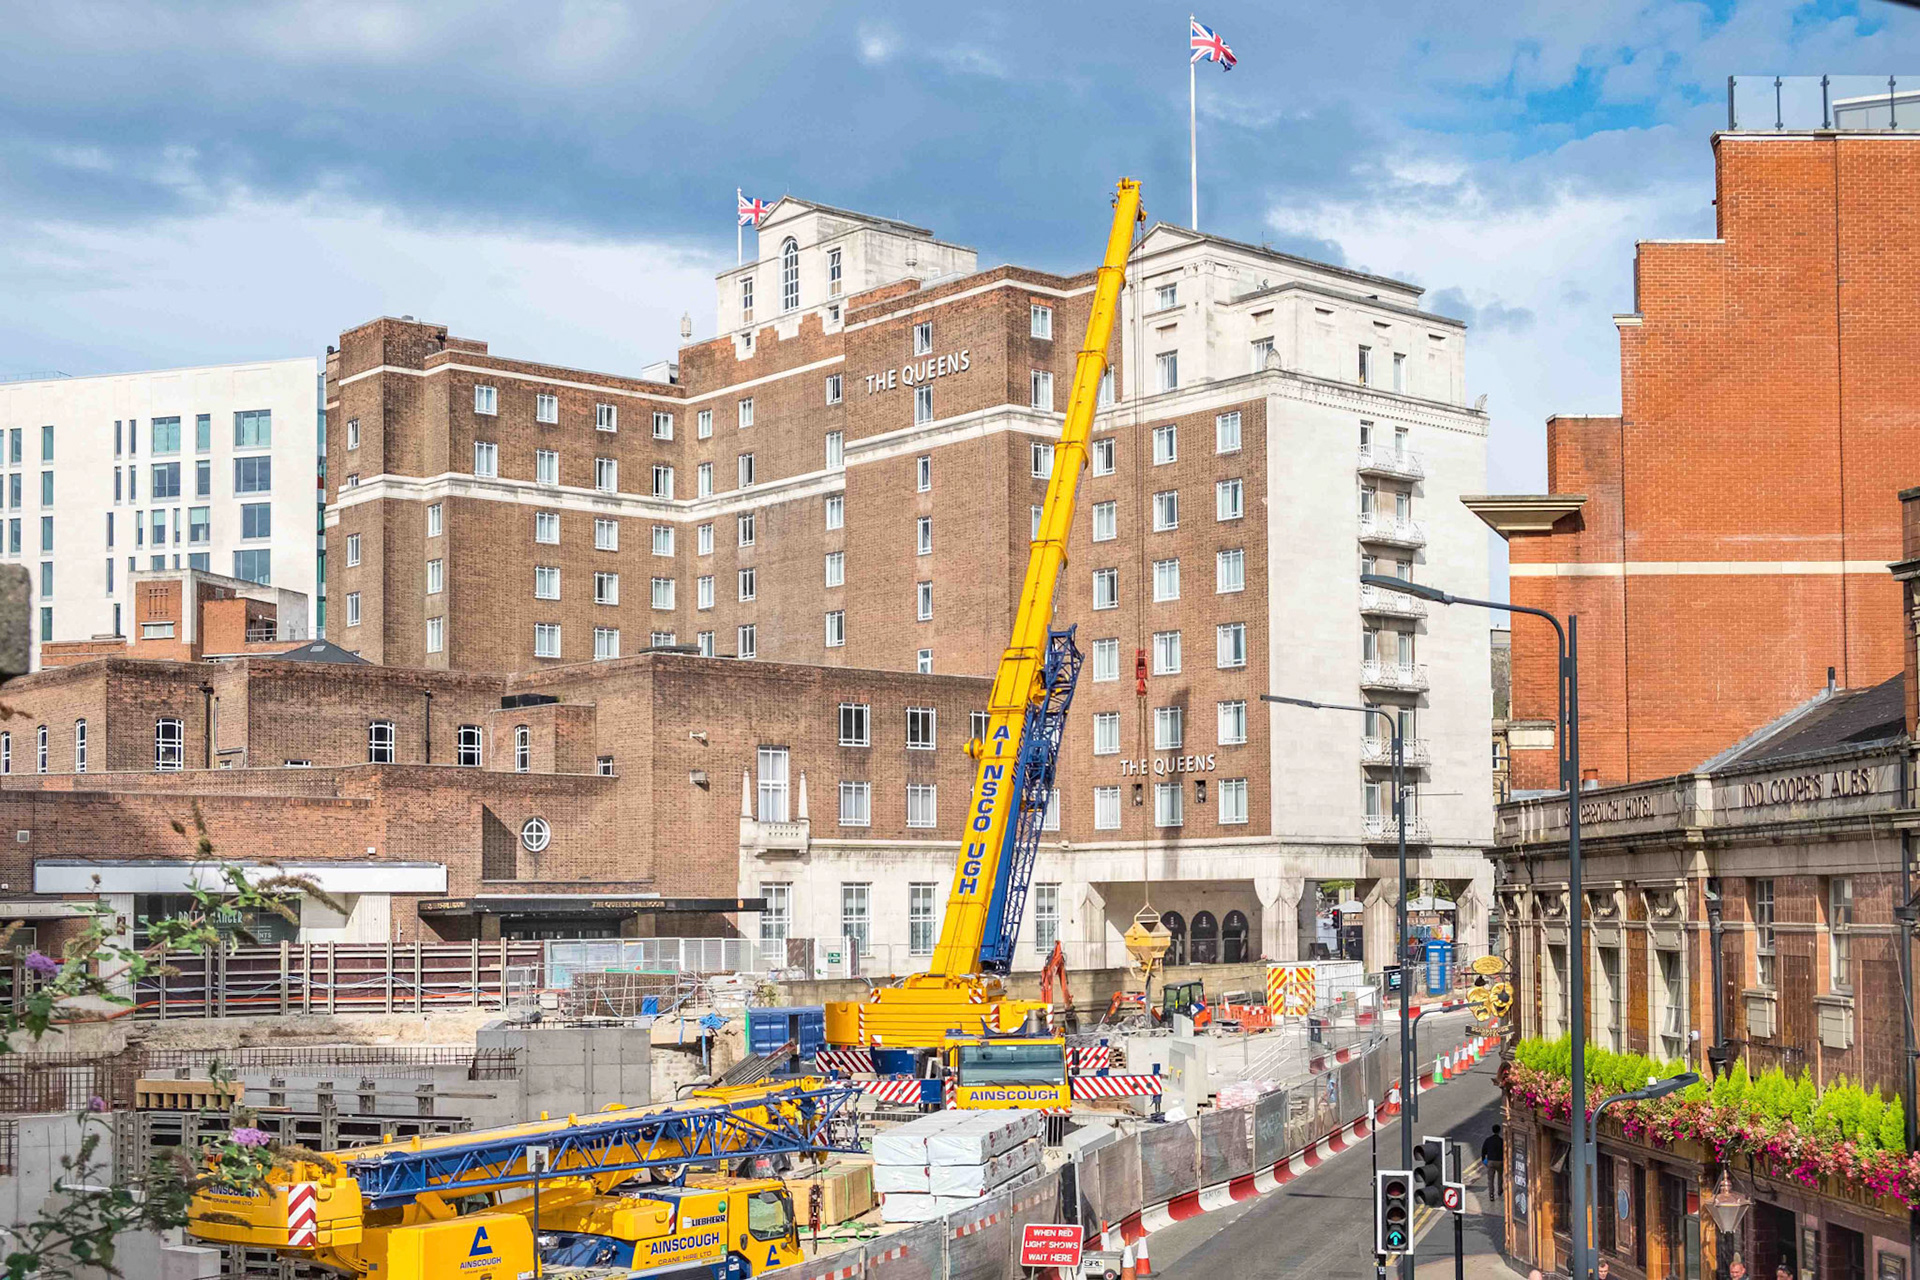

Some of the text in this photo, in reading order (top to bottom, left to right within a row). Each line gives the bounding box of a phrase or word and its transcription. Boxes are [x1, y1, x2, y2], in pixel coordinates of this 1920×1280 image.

[865, 350, 970, 395] THE QUEENS
[1120, 753, 1216, 776] THE QUEENS
[1831, 768, 1870, 797] ALES
[1625, 795, 1654, 819] HOTEL
[970, 1090, 1059, 1101] AINSCOUGH
[691, 1214, 726, 1227] LIEBHERR
[1033, 1229, 1074, 1237] WHEN RED
[651, 1231, 720, 1255] AINSCOUGH
[1025, 1240, 1079, 1249] LIGHT SHOWS
[460, 1256, 502, 1269] AINSCOUGH
[658, 1256, 681, 1265] CRANE
[682, 1253, 698, 1261] HIRE
[1028, 1253, 1073, 1262] WAIT HERE
